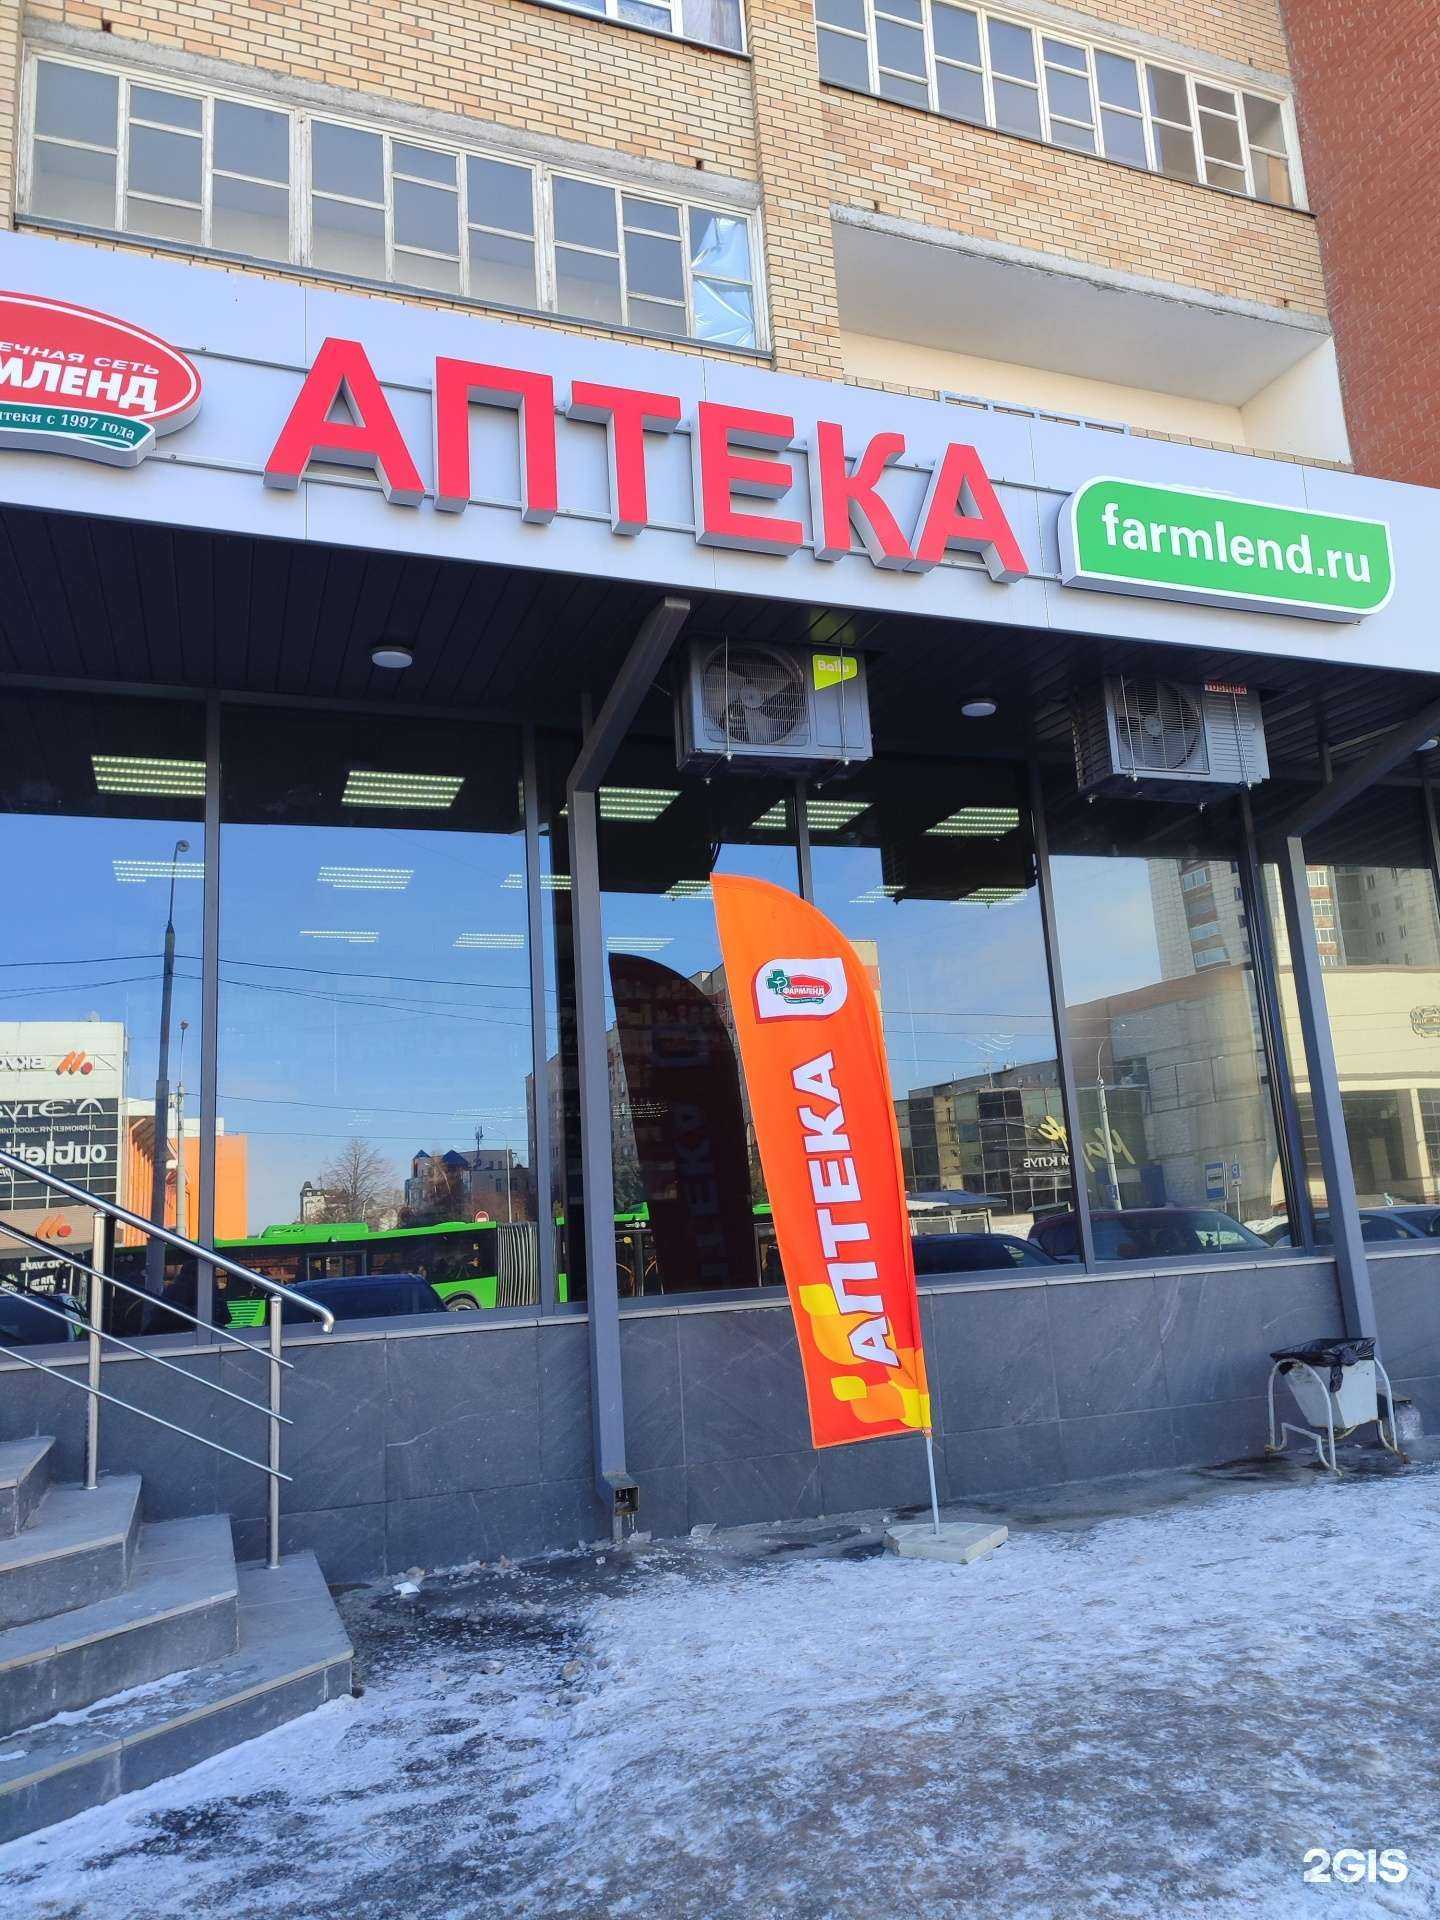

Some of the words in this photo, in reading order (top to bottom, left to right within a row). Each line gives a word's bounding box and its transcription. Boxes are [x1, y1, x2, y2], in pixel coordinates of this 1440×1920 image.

[93, 356, 160, 375] СЕТЬ
[0, 410, 42, 424] теки
[46, 414, 55, 425] с
[61, 413, 98, 429] 1997
[101, 422, 136, 441] года
[264, 337, 1029, 580] АПТЕКА
[1101, 502, 1371, 584] farmlend.ru
[791, 1050, 900, 1367] АПТЕКА
